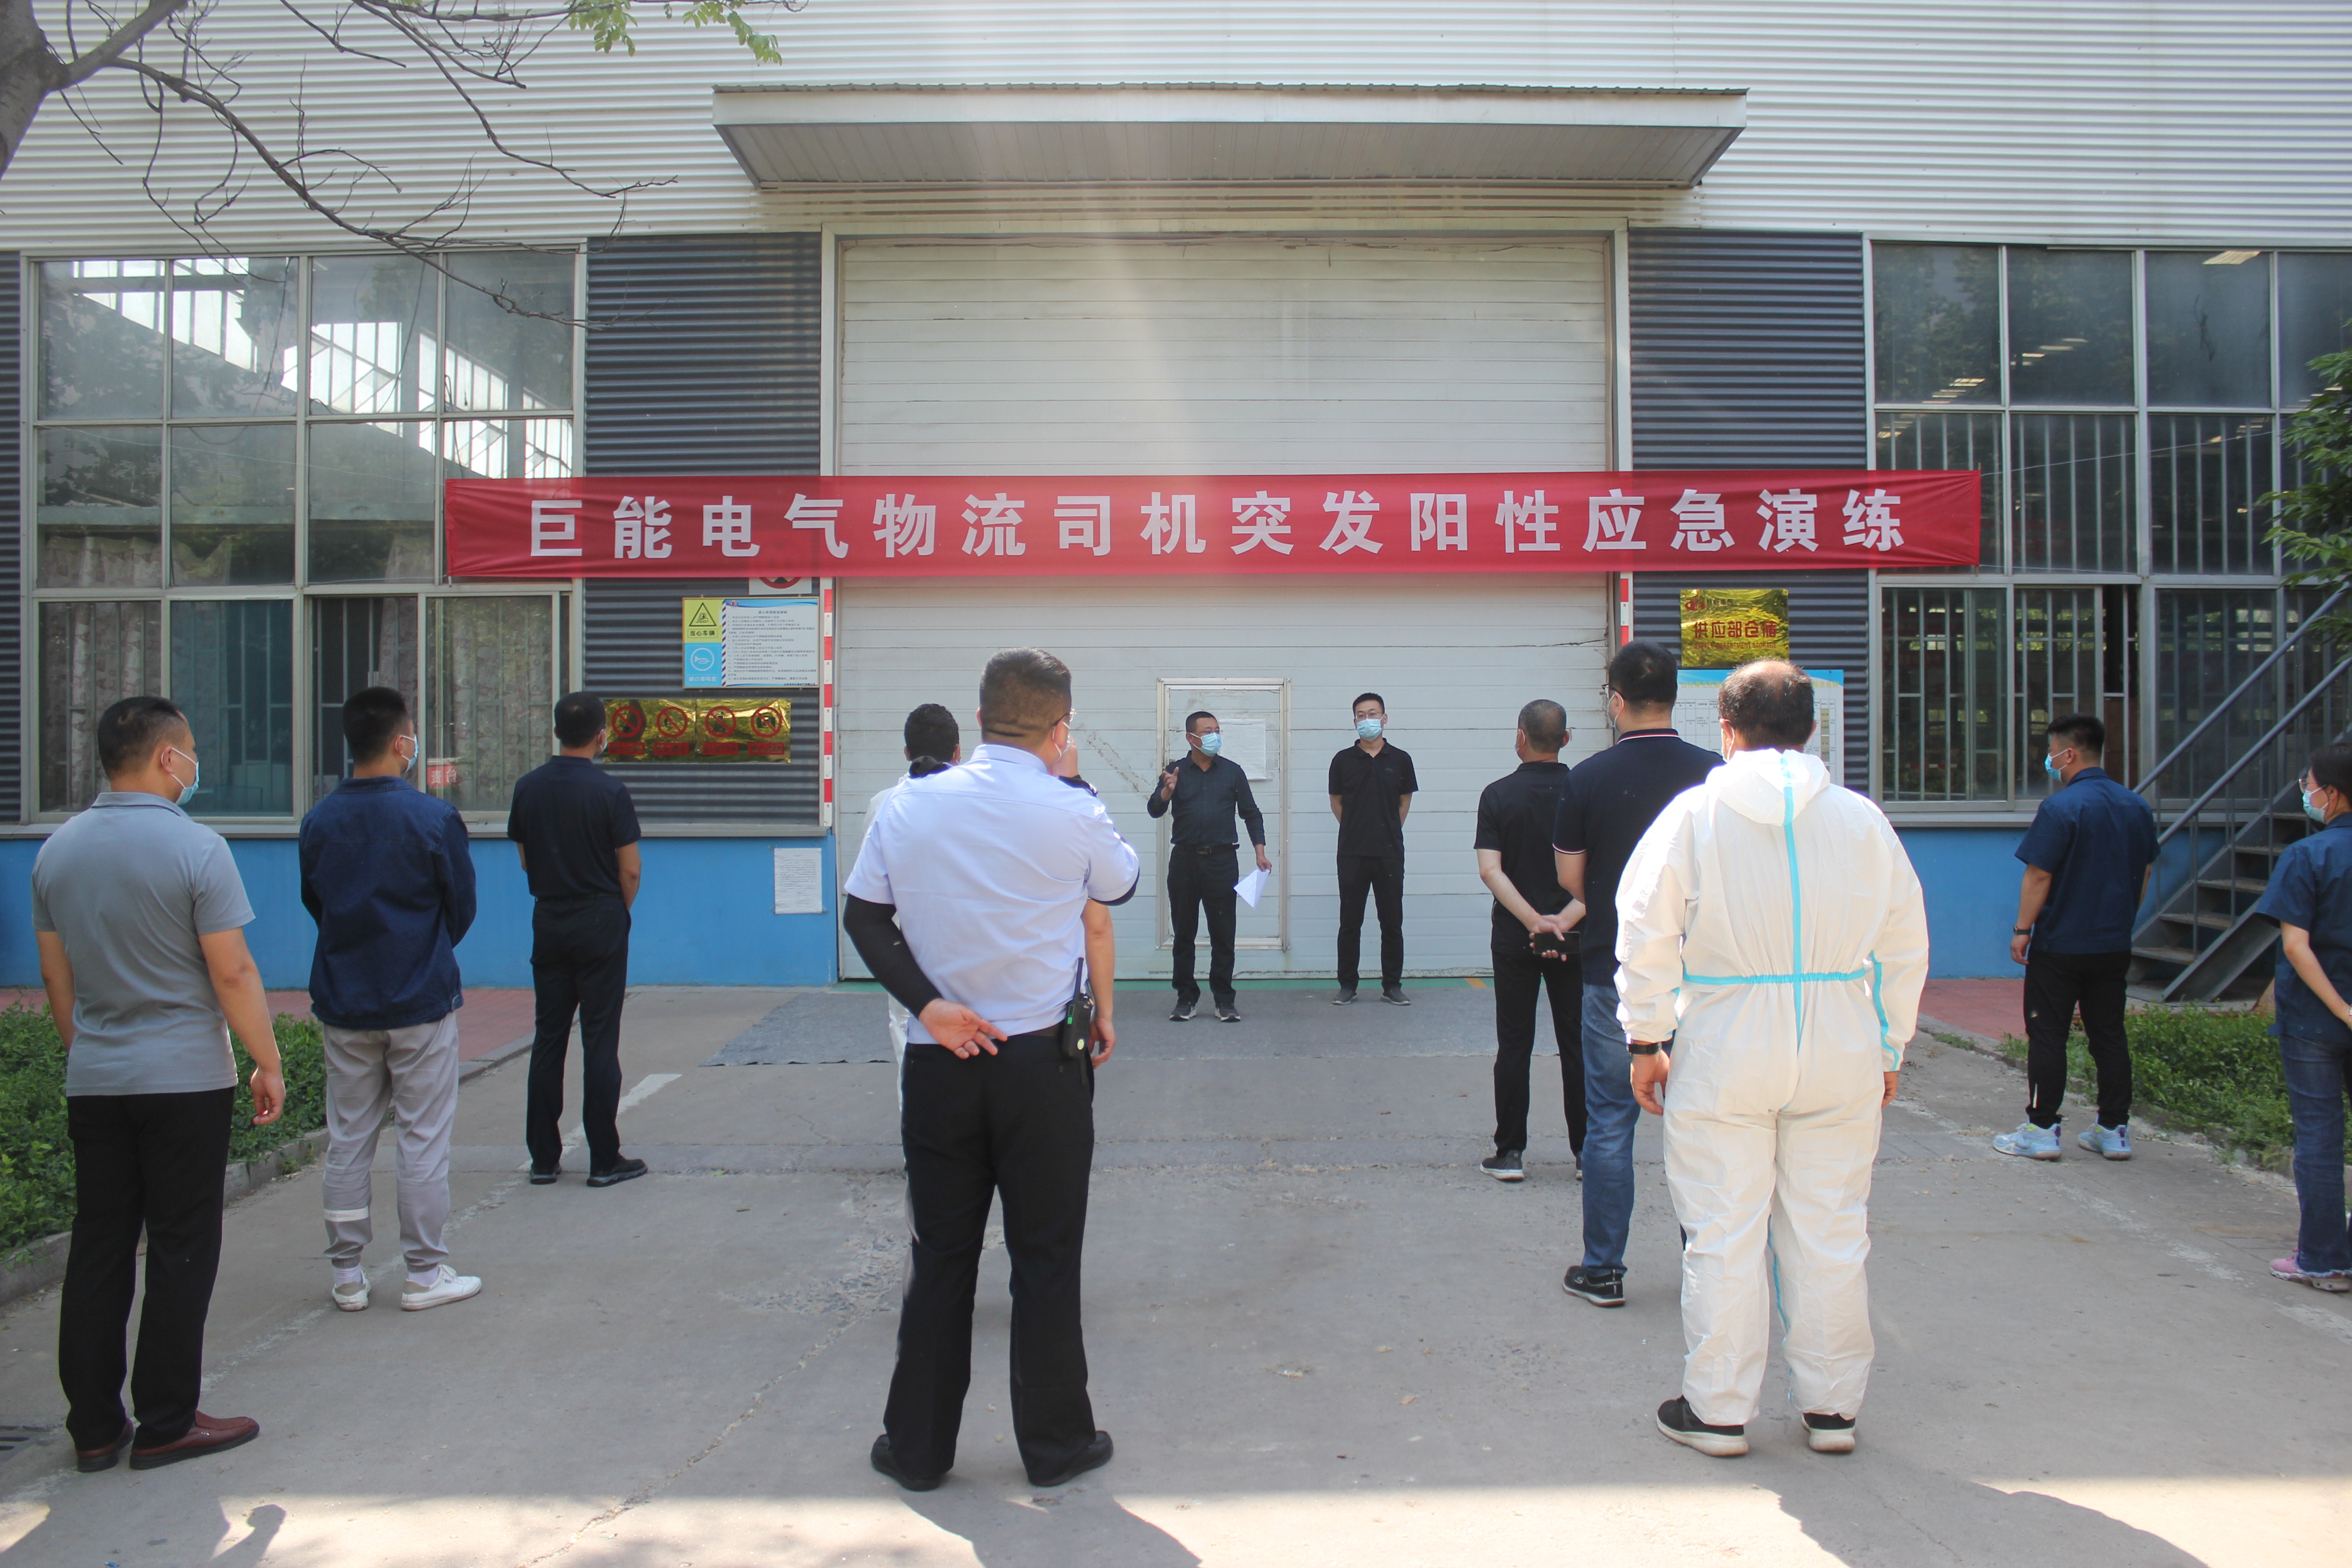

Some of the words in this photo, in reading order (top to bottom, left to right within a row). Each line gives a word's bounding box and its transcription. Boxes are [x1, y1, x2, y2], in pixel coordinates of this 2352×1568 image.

[530, 489, 1904, 559] 巨能电气物流司机突发阳性应急演练
[1695, 621, 1777, 638] 供应部仓储
